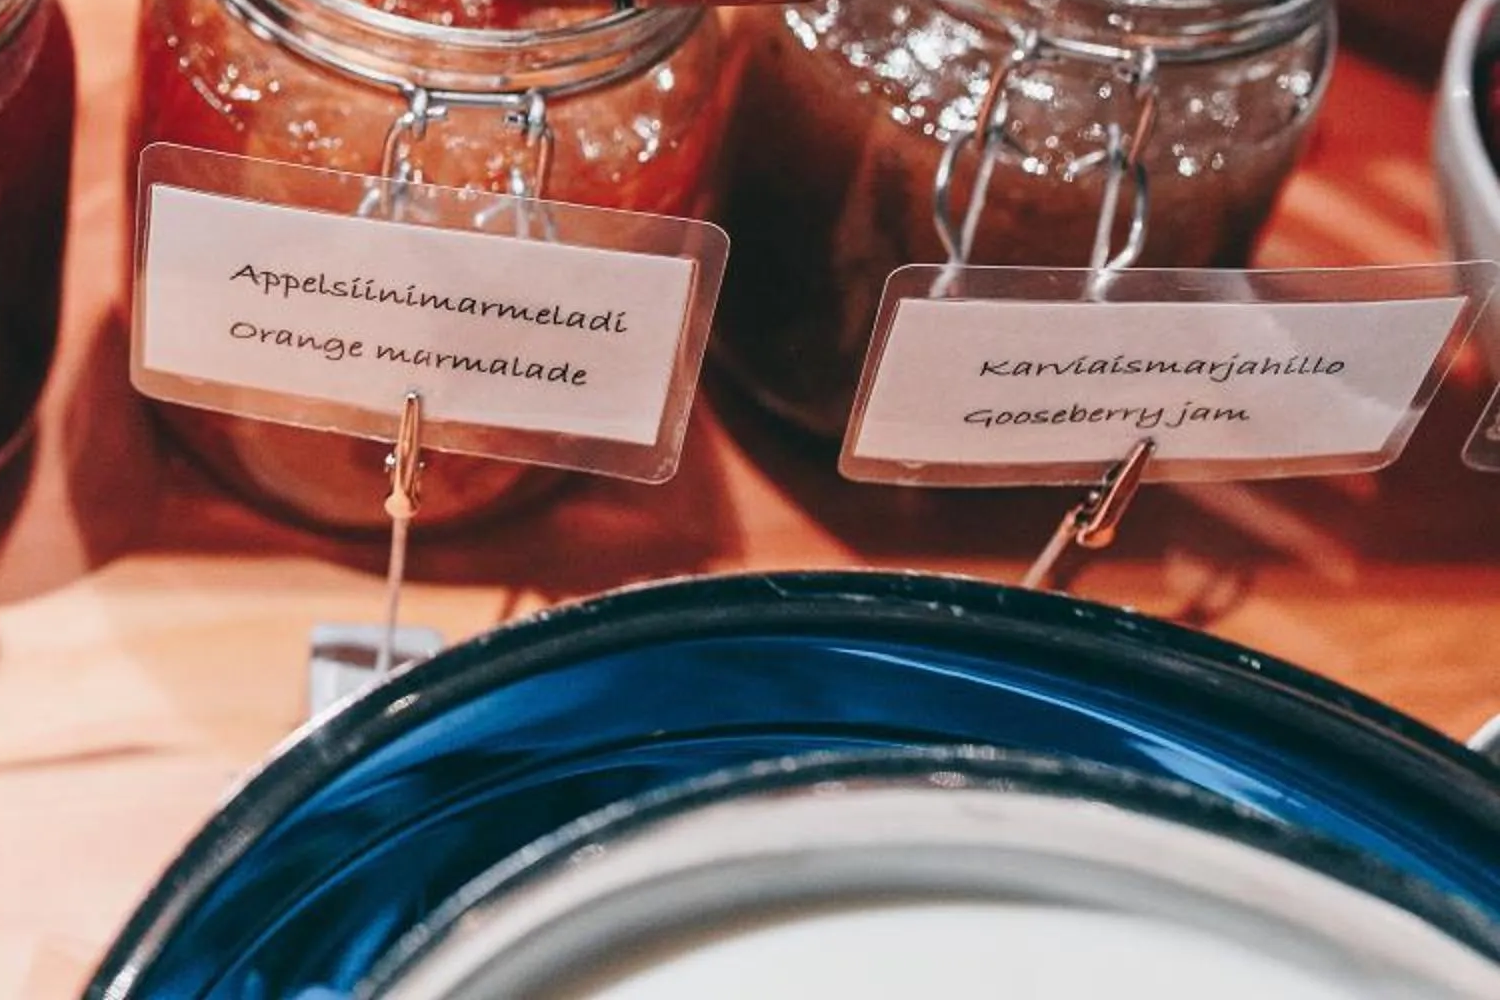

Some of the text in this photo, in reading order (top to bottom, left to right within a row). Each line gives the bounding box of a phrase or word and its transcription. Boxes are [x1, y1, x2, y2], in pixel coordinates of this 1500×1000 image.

[228, 263, 629, 334] Appelsiinimarmeladi
[228, 319, 589, 387] Orange marmalade
[978, 353, 1346, 383] Karviaismarjahillo
[962, 399, 1251, 429] Gooseberry jam
